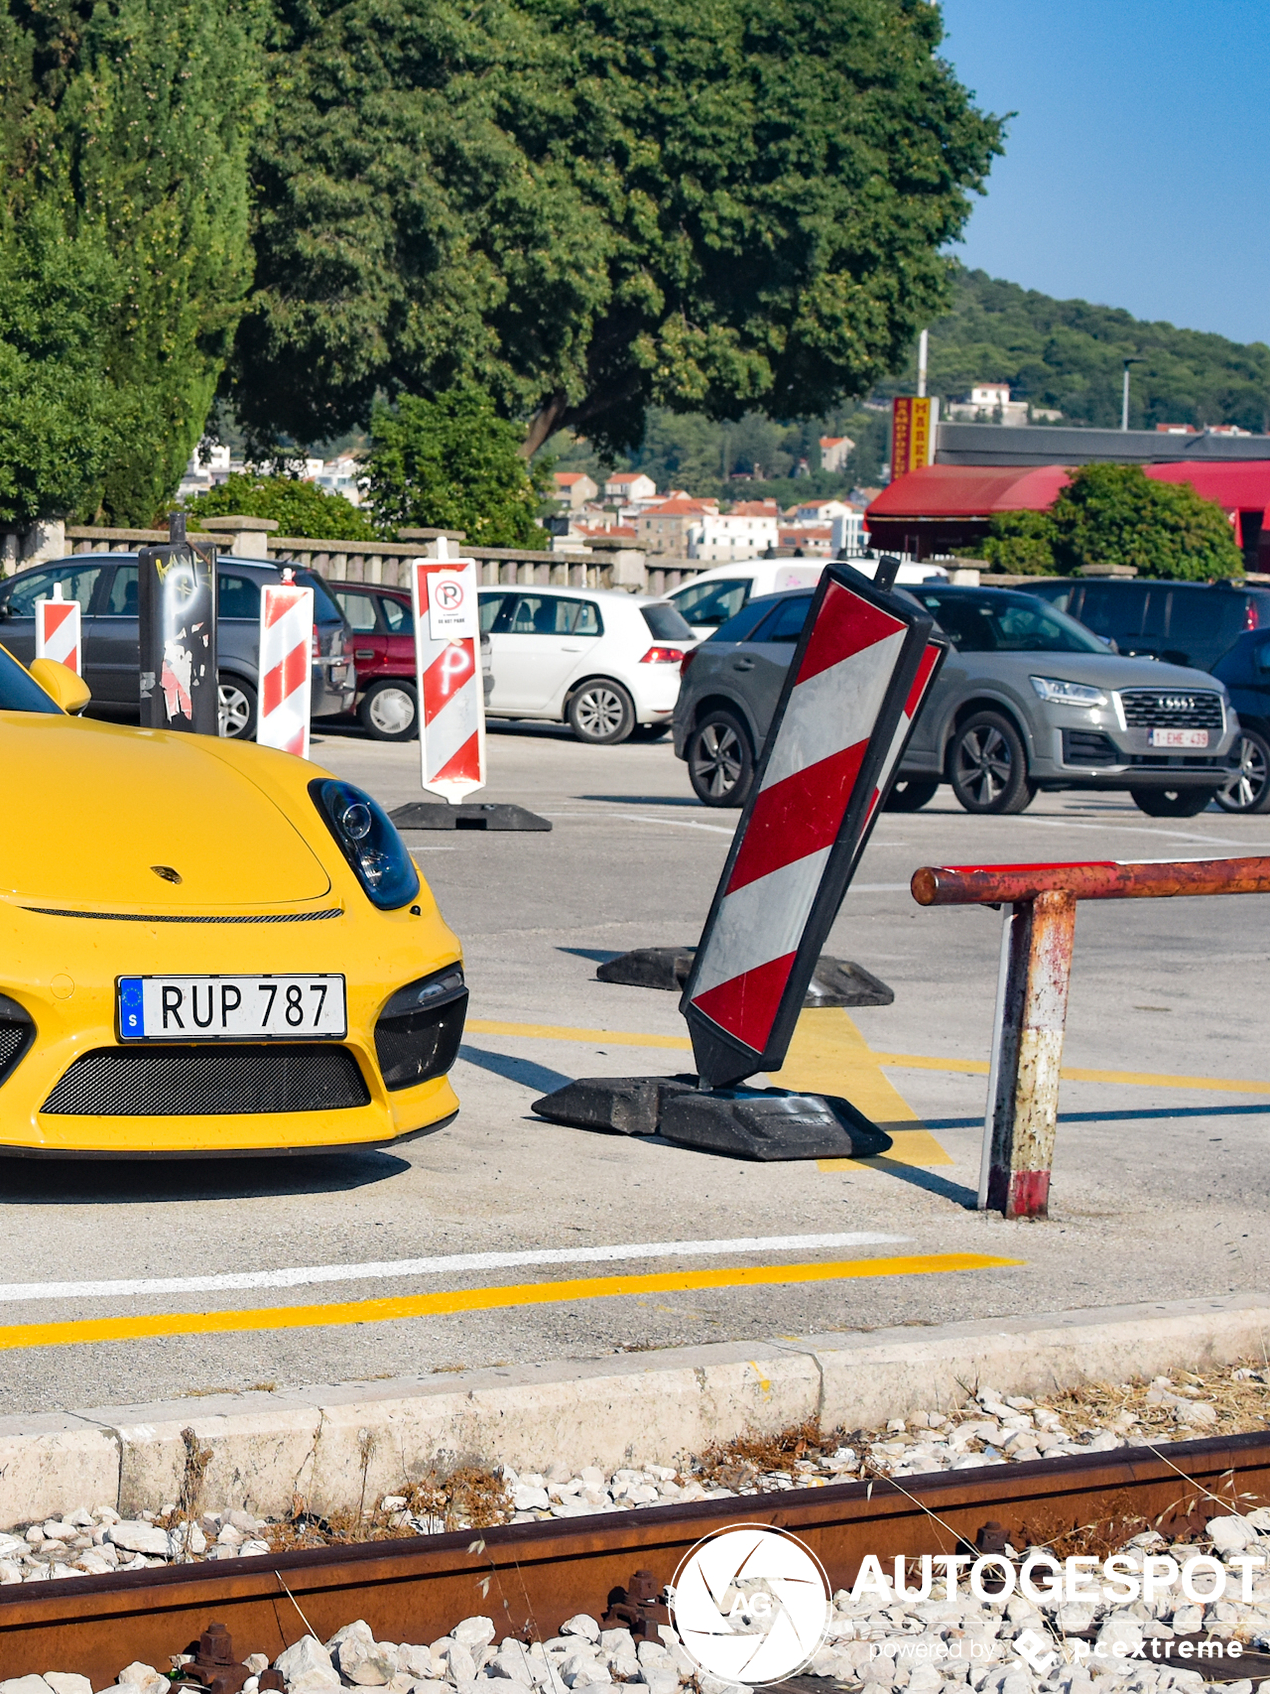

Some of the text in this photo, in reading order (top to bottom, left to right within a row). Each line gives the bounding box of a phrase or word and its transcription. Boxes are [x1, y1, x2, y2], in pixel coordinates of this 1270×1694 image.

[441, 646, 470, 695] P
[128, 1014, 138, 1027] S
[161, 984, 328, 1029] RUP 787
